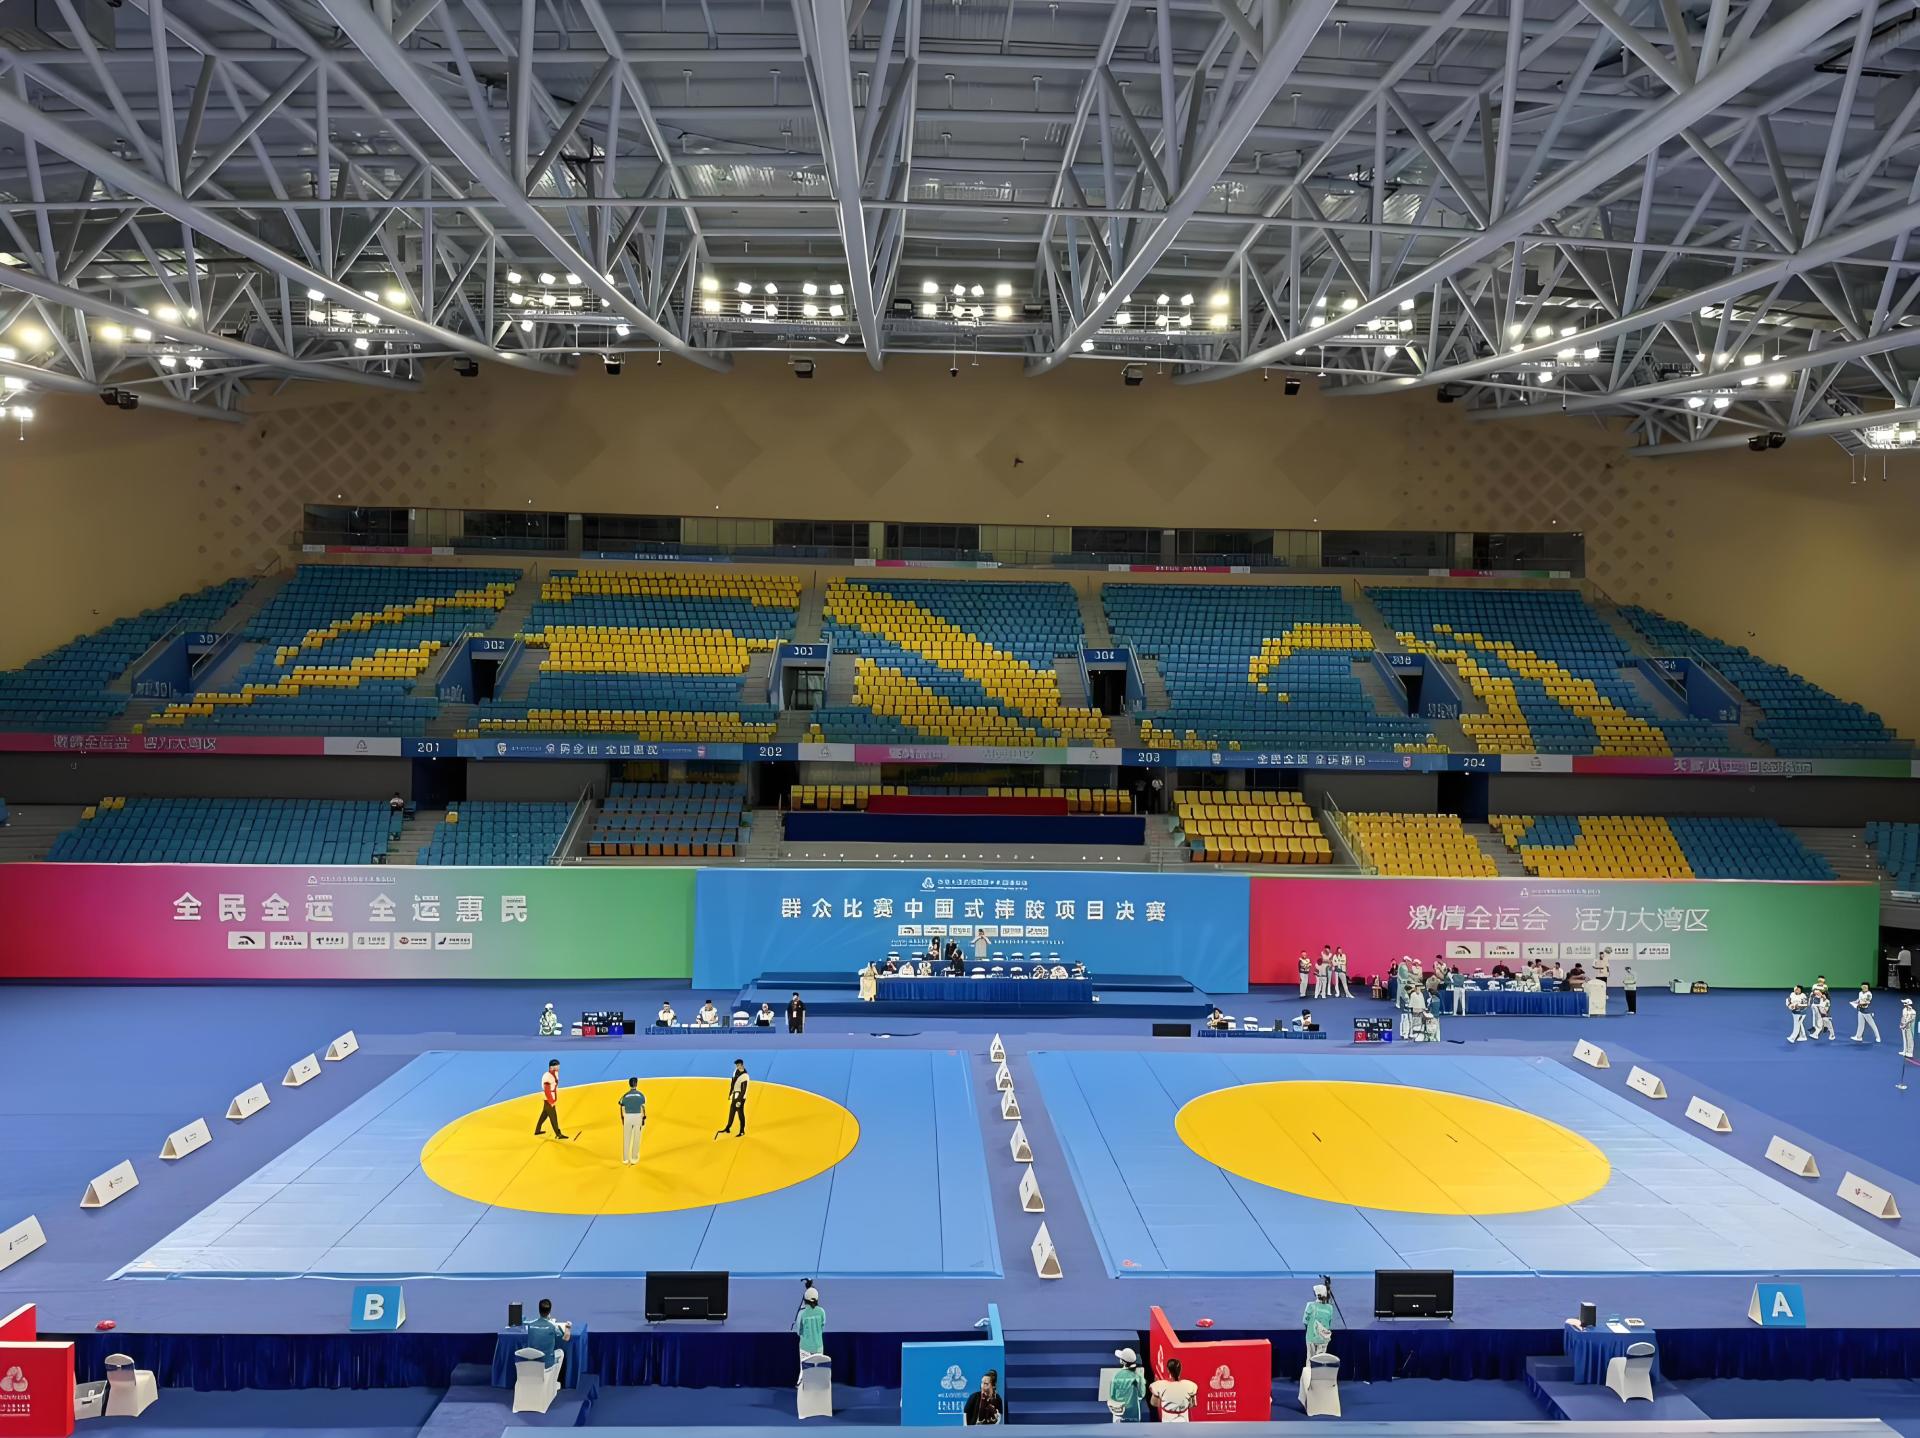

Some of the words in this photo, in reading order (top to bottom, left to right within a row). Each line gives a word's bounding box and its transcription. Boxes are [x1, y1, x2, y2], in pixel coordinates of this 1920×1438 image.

[417, 742, 440, 753] 201
[759, 746, 782, 757] 202
[1463, 757, 1486, 768] 204
[173, 891, 334, 922] 全民全运
[369, 892, 528, 923] 全运惠民
[1406, 904, 1552, 931] 激情全运会
[1571, 905, 1711, 932] 活力大湾区
[363, 1293, 385, 1321] B
[1771, 1291, 1794, 1318] A
